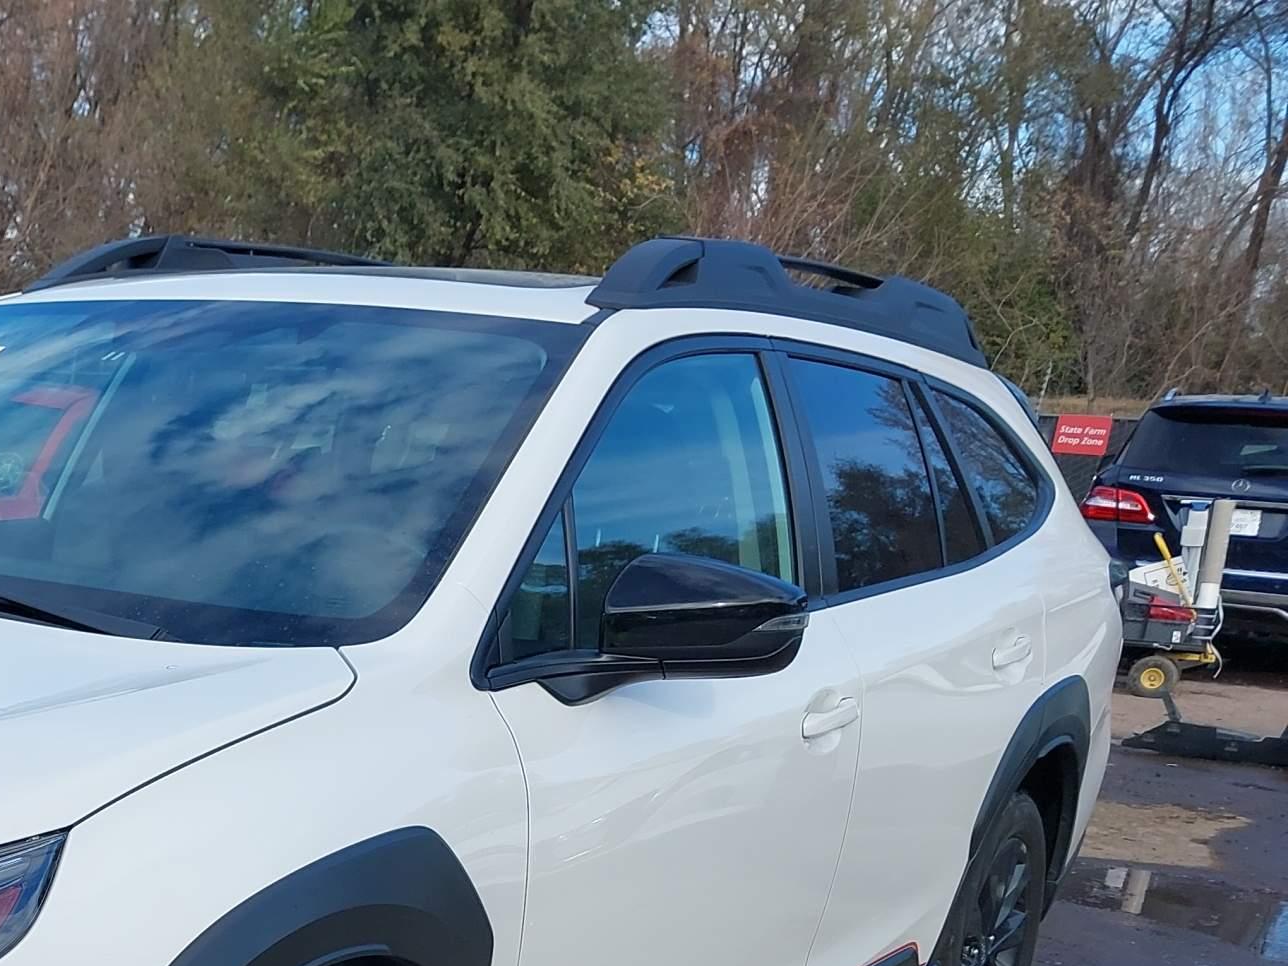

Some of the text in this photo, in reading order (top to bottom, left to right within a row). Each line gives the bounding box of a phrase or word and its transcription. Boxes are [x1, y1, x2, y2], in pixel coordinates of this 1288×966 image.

[1059, 425, 1107, 435] State Farm
[1057, 436, 1104, 447] Drop Zone
